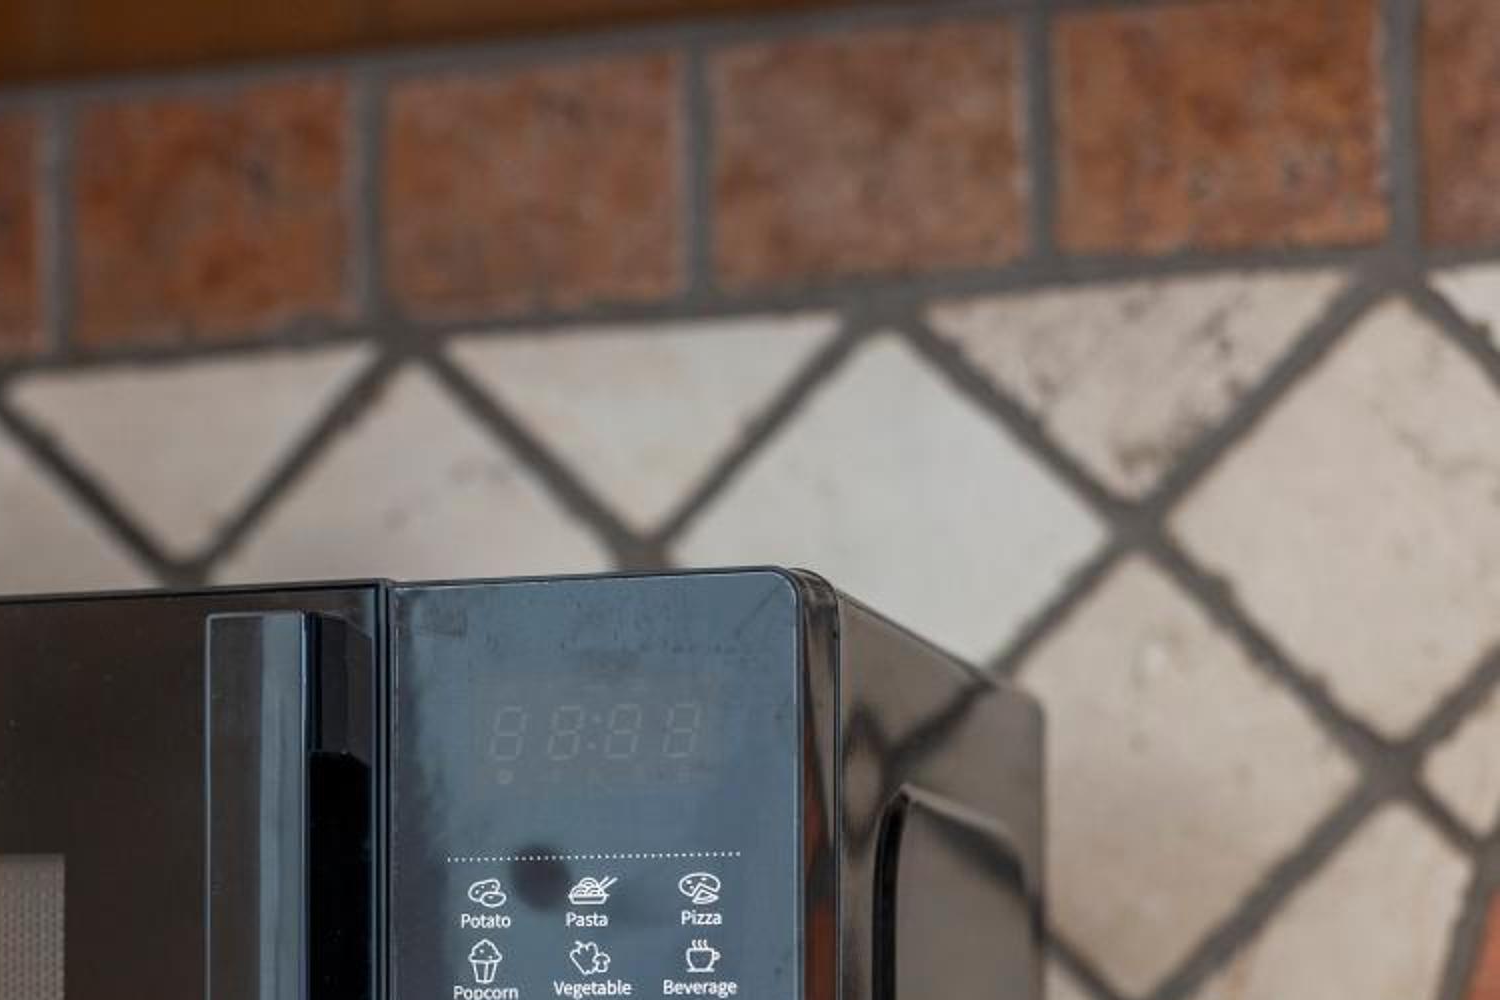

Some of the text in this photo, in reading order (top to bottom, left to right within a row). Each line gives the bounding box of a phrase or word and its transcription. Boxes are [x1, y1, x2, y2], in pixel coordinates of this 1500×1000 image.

[460, 913, 511, 929] Potato
[565, 912, 608, 927] Pasta
[681, 910, 723, 926] Pizza
[553, 981, 631, 999] Vegetable
[663, 980, 738, 998] Beverage
